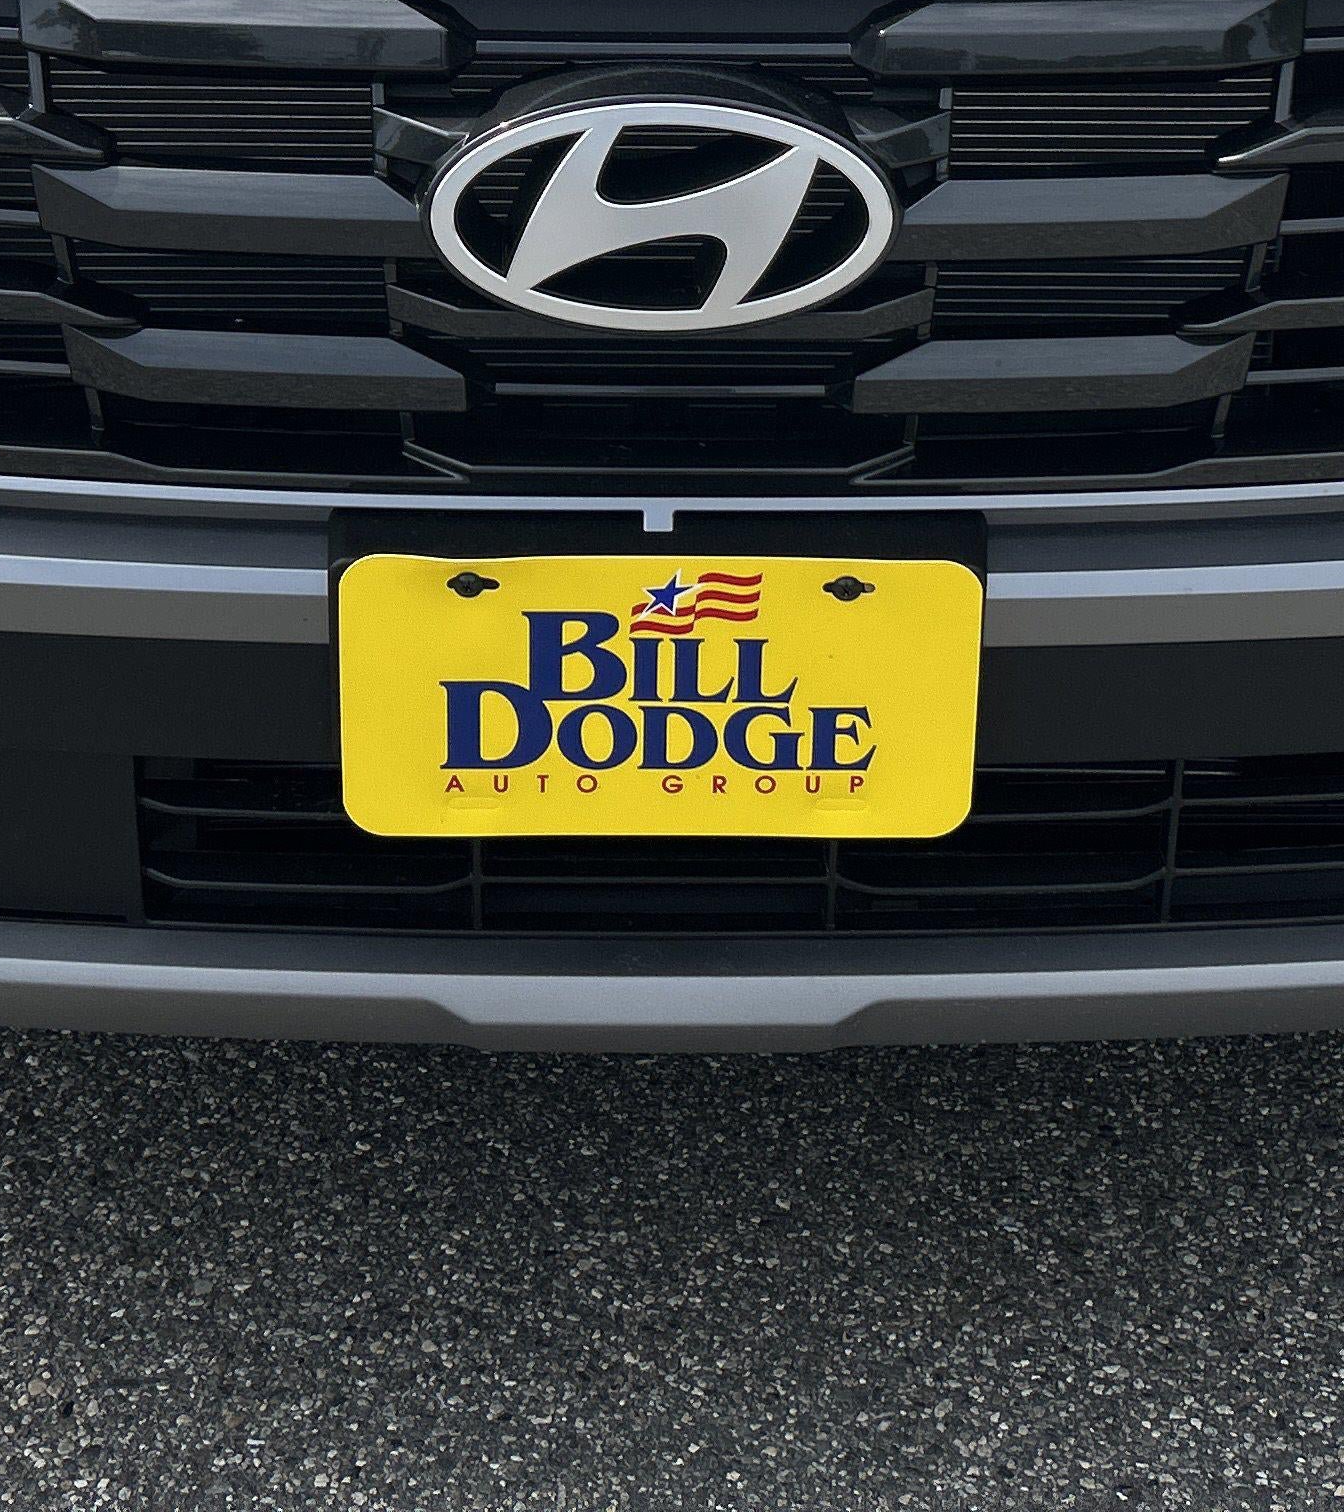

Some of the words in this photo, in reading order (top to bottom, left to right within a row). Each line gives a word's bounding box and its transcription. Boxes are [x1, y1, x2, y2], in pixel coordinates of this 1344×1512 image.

[521, 609, 799, 704] BILL
[438, 679, 879, 772] DODGE
[444, 774, 600, 795] AUTO
[660, 774, 866, 795] GROUP
